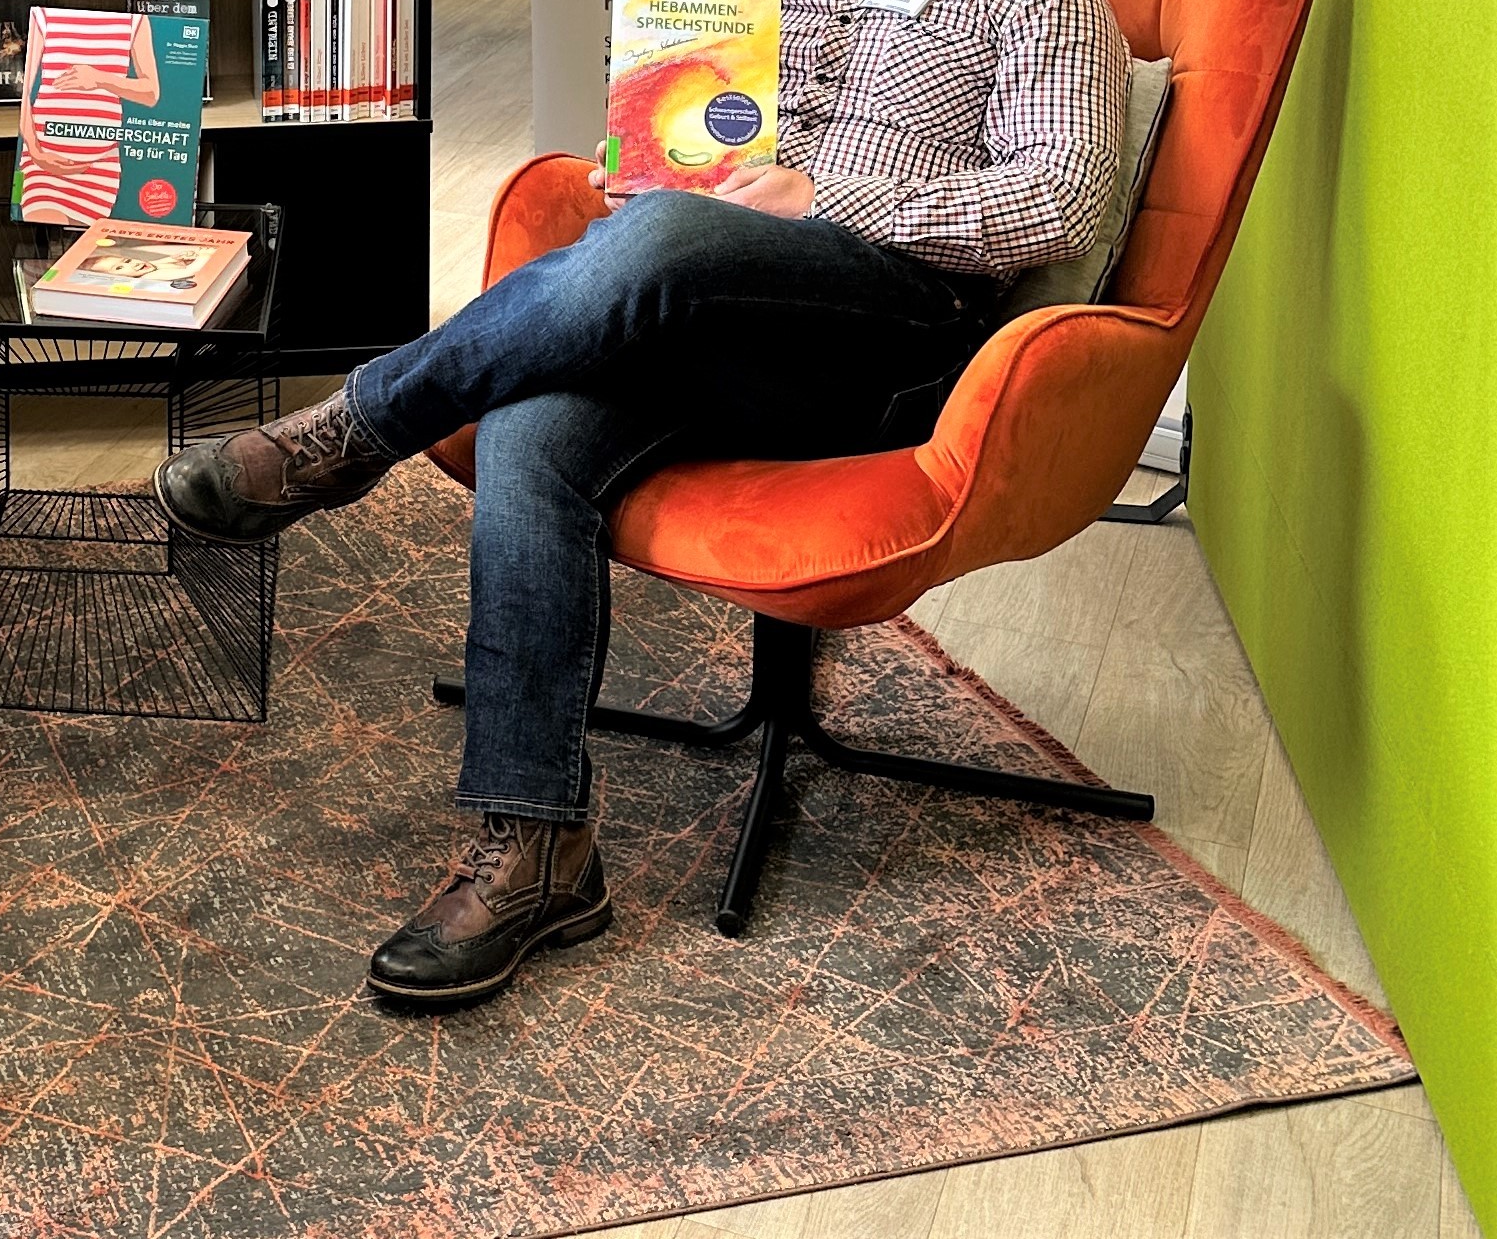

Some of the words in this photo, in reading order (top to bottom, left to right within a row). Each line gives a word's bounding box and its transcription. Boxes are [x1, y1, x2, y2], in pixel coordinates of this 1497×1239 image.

[173, 2, 198, 14] dem
[649, 0, 744, 17] HEBAMMEN-
[636, 16, 755, 35] SPRECHSTUNDE
[267, 10, 278, 61] NIEMAND
[127, 116, 146, 127] Alles
[168, 121, 191, 130] meine
[45, 122, 190, 147] SCHWANGERSCHAFT
[124, 145, 144, 161] Tag
[146, 146, 165, 159] für
[168, 150, 188, 164] Tag
[146, 233, 196, 242] ERSTES
[199, 237, 235, 245] JAHR
